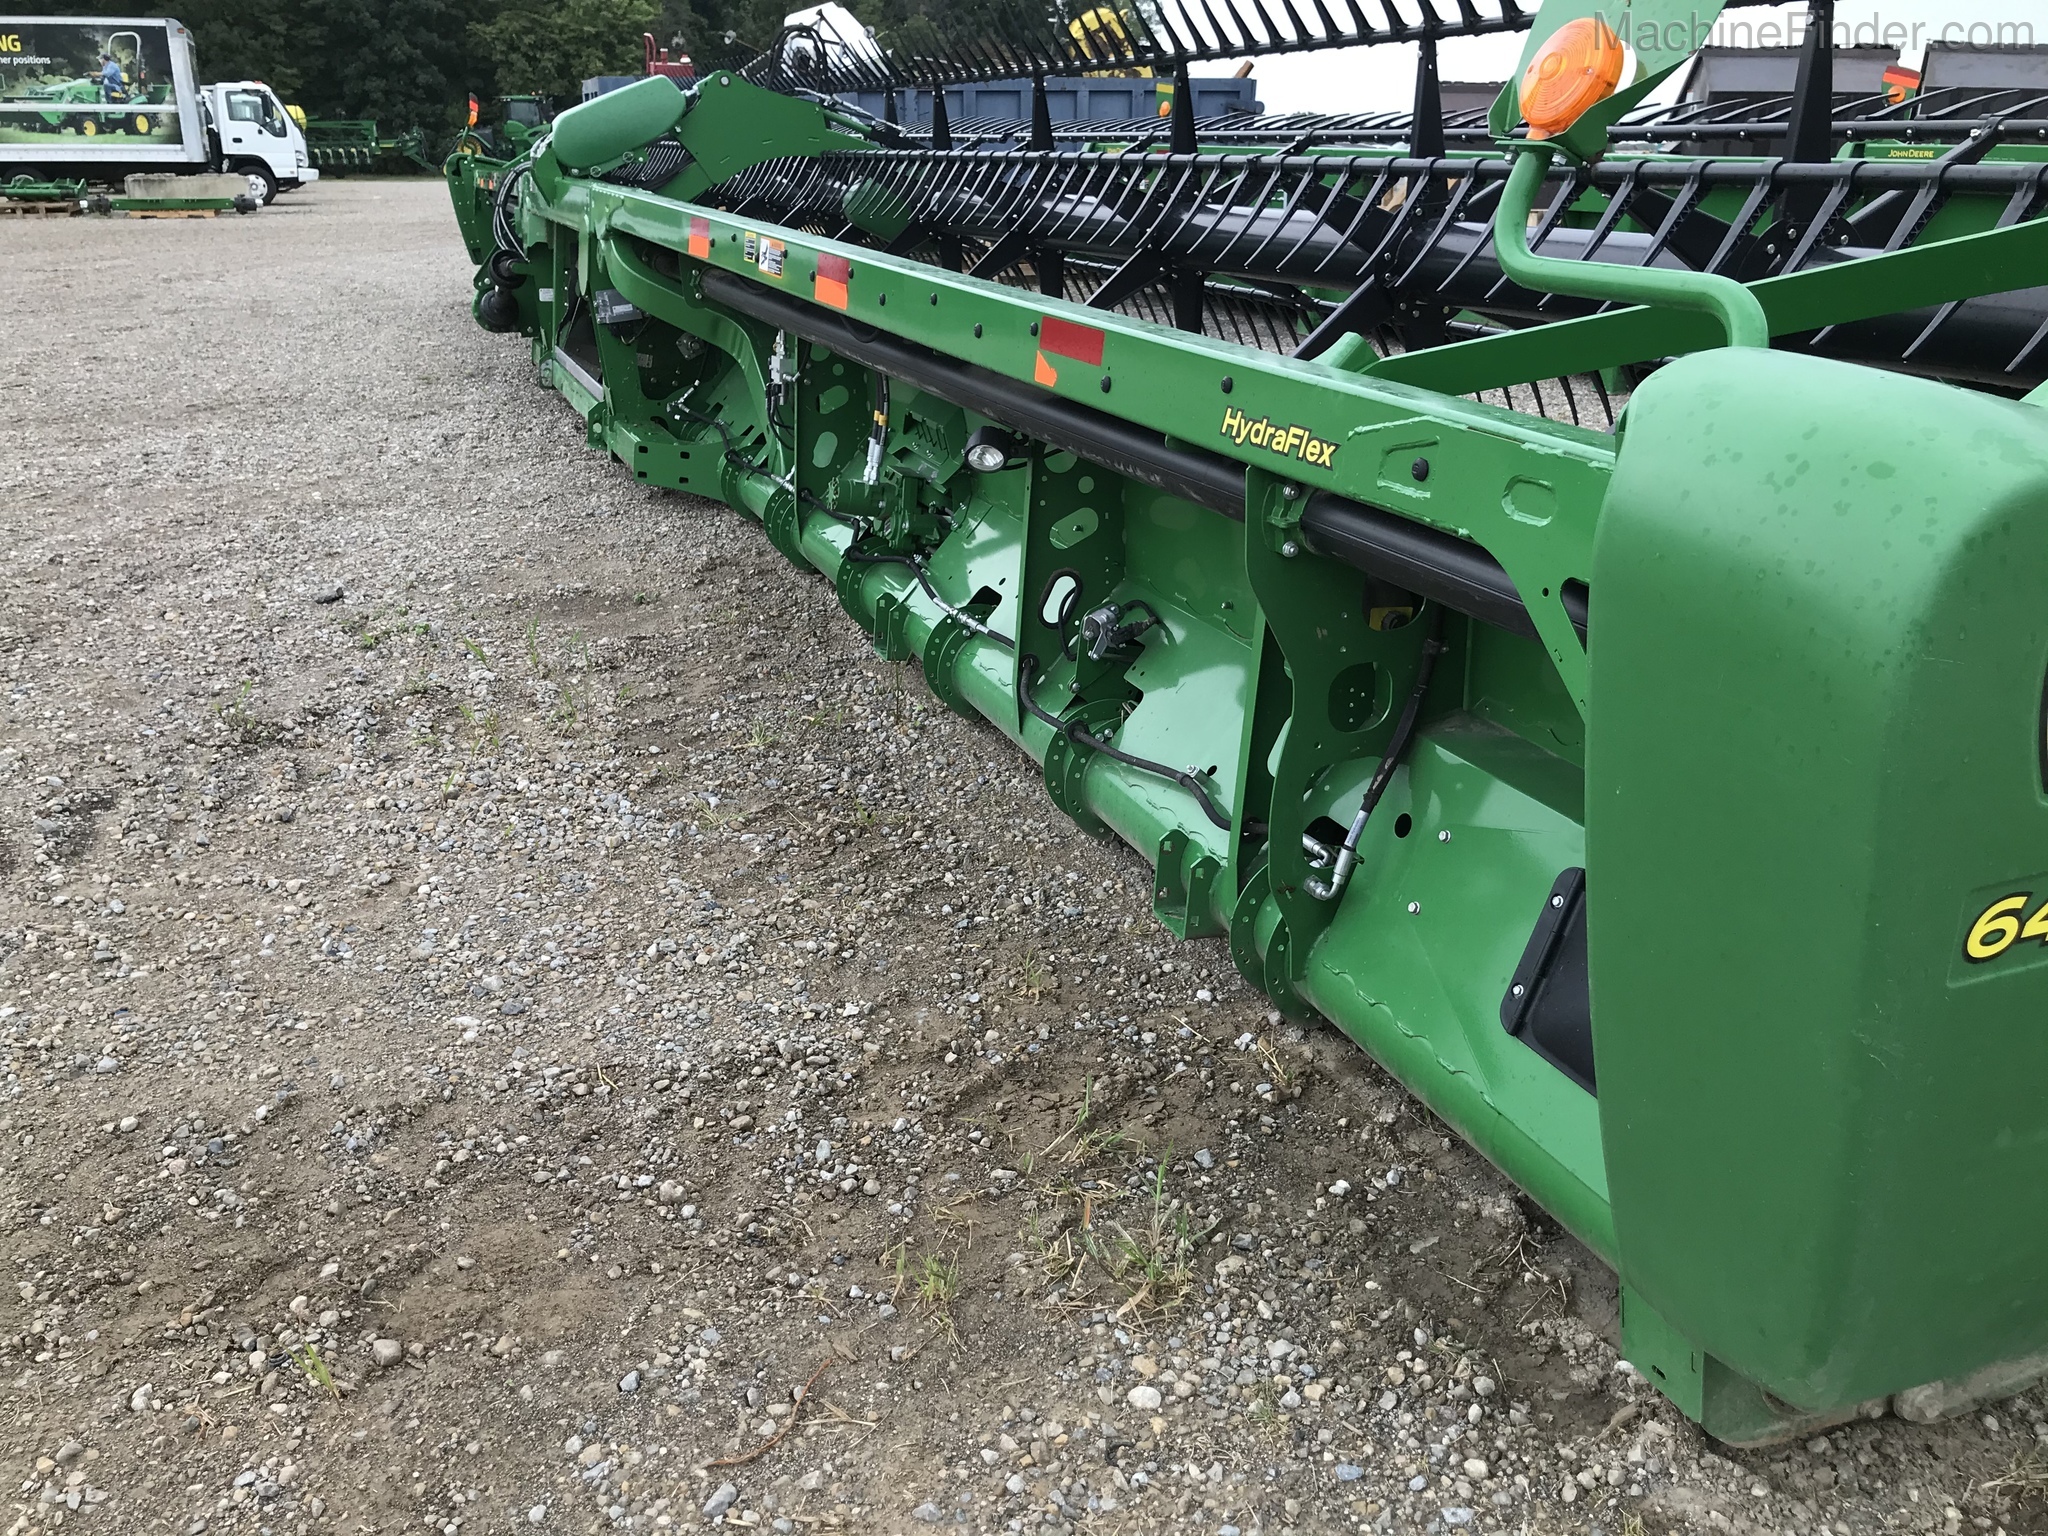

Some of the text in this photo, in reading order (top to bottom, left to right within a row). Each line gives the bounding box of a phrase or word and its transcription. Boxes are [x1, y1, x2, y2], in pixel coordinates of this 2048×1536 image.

[13, 55, 51, 66] positions
[1888, 149, 1934, 158] JOHN DEERE
[1220, 405, 1340, 470] HydraFlex
